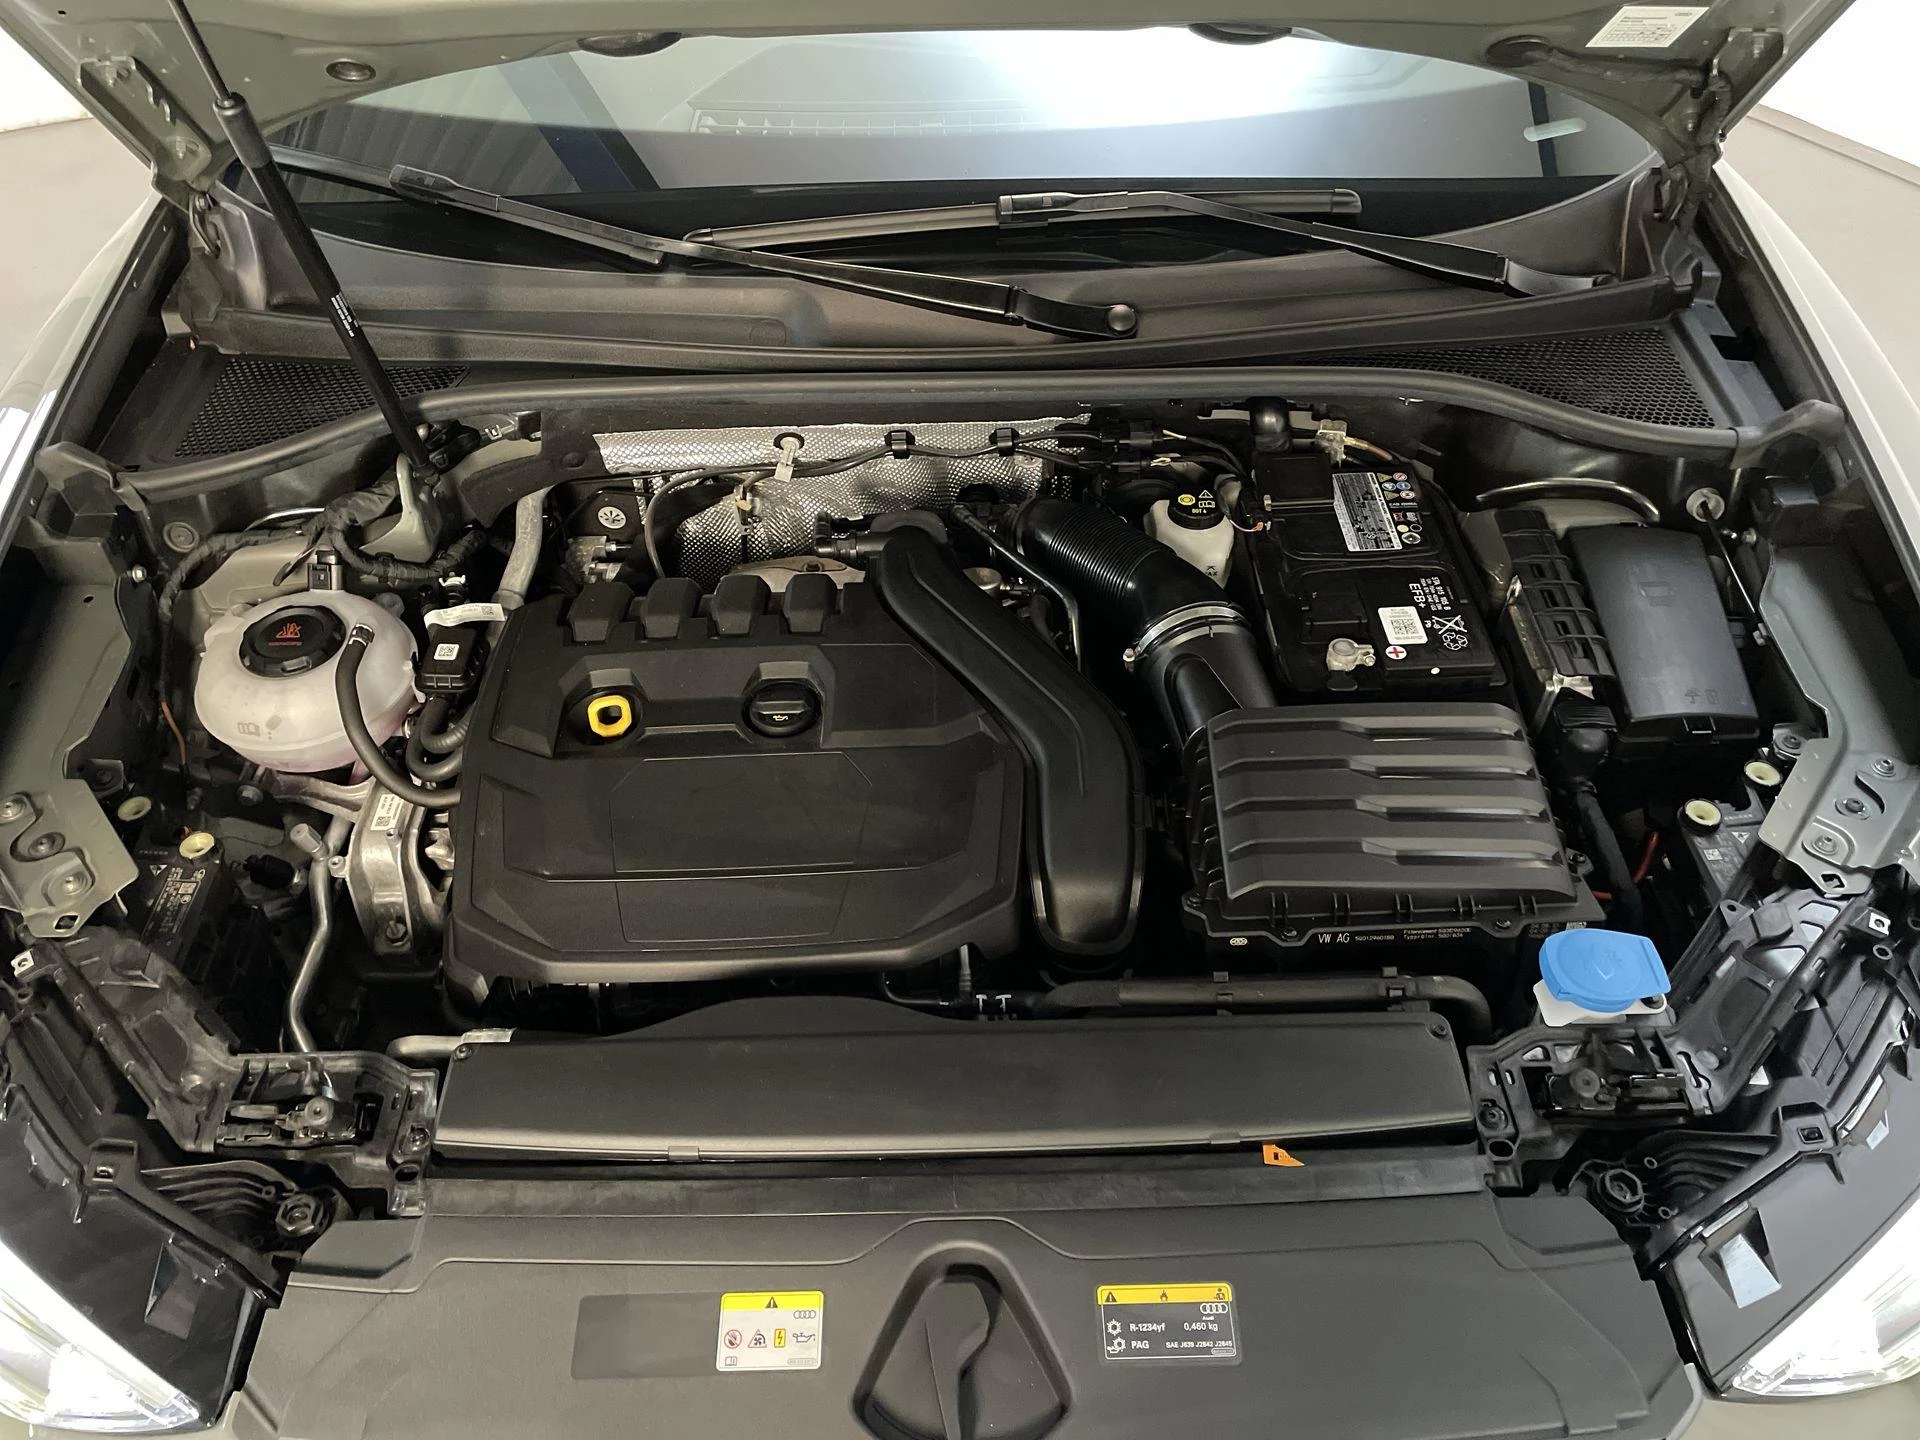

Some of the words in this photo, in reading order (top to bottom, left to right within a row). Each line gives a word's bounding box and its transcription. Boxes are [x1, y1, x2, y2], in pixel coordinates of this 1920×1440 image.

[1409, 583, 1426, 608] EFB+
[1318, 934, 1331, 943] VW
[1336, 933, 1350, 943] AG
[1130, 1322, 1165, 1332] R-1234yf
[1184, 1322, 1206, 1331] 0,460
[1208, 1322, 1218, 1331] kg
[1131, 1340, 1150, 1349] PAG
